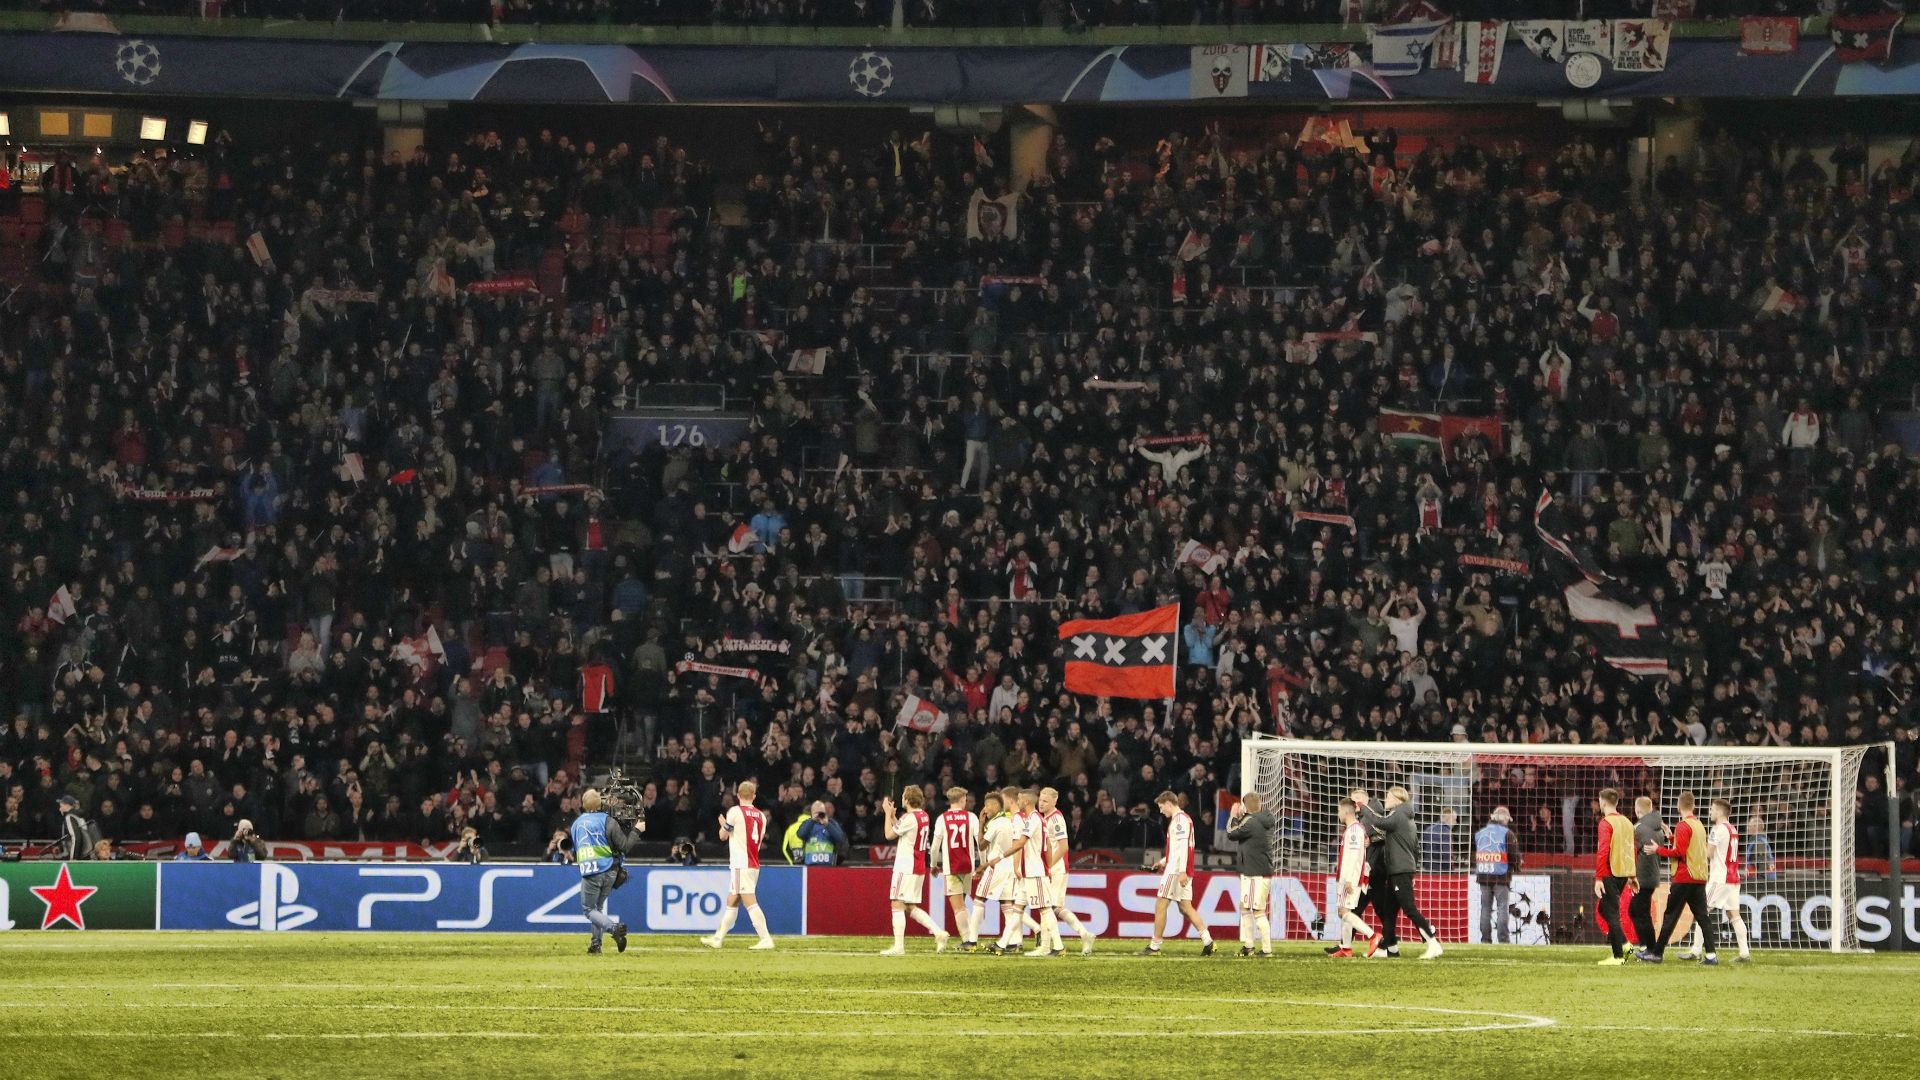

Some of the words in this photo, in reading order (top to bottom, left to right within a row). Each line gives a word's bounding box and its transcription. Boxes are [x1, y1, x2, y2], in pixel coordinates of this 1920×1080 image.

[658, 424, 704, 447] 126
[751, 820, 759, 844] 4
[949, 823, 967, 849] 21
[812, 853, 829, 863] 008
[1476, 853, 1501, 862] PHOTO
[579, 861, 599, 875] 021
[1478, 863, 1495, 873] 053
[358, 868, 619, 929] PS4
[661, 885, 722, 916] Pro
[1029, 895, 1039, 906] 22
